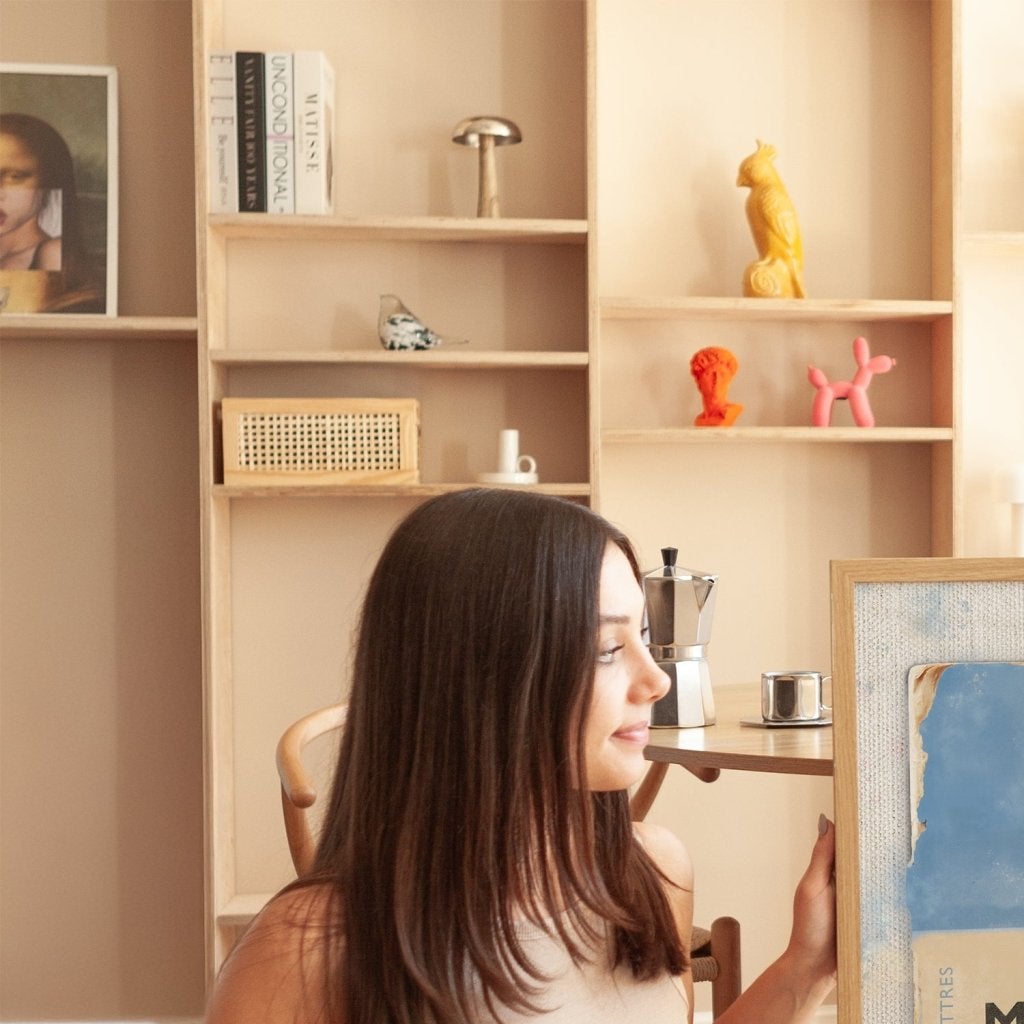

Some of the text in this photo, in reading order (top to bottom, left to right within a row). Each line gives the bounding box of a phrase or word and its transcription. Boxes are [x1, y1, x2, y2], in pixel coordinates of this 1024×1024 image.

[210, 55, 234, 126] ELLE
[243, 58, 255, 105] VANITY
[243, 109, 255, 140] FAIR
[271, 56, 289, 204] UNCONDITIONAL
[305, 93, 320, 174] MATISSE
[245, 167, 257, 209] YEARS
